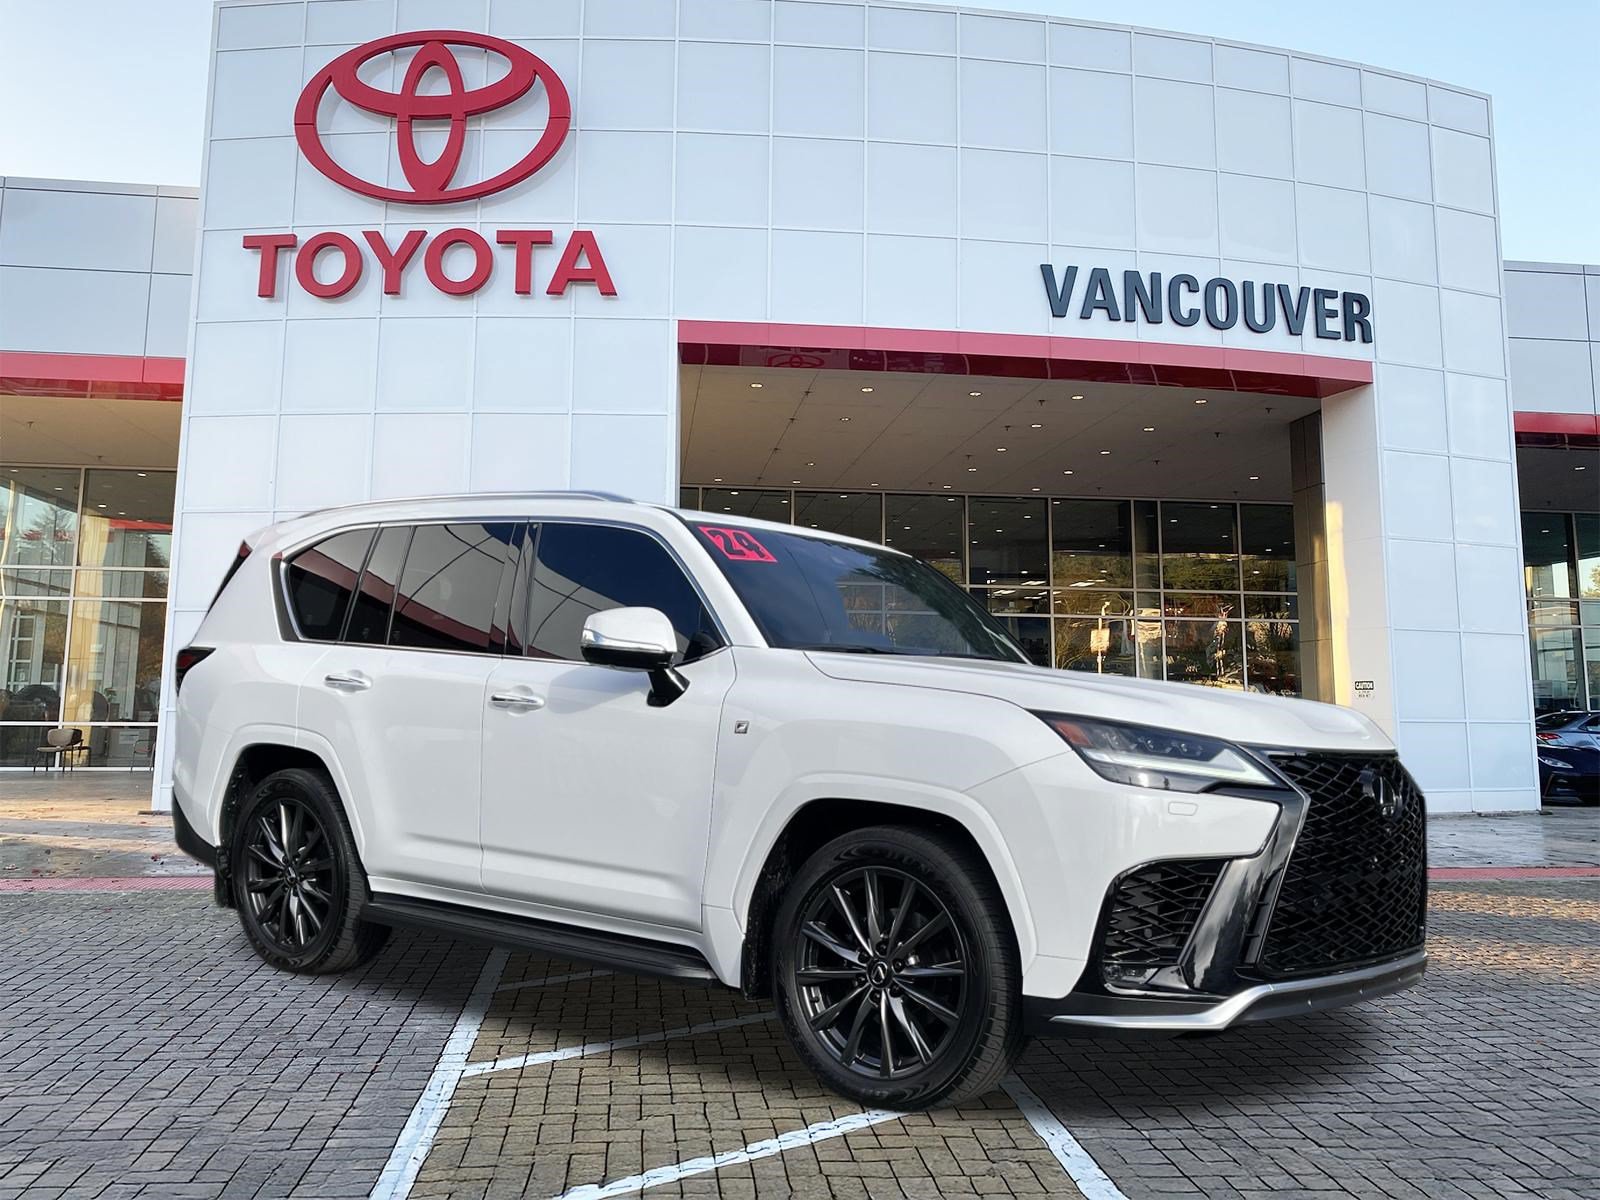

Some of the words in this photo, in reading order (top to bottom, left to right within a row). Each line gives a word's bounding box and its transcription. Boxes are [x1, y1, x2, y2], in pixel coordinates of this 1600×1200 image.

[243, 227, 618, 299] TOYOTA
[1040, 263, 1374, 344] VANCOUVER
[705, 529, 766, 558] 24
